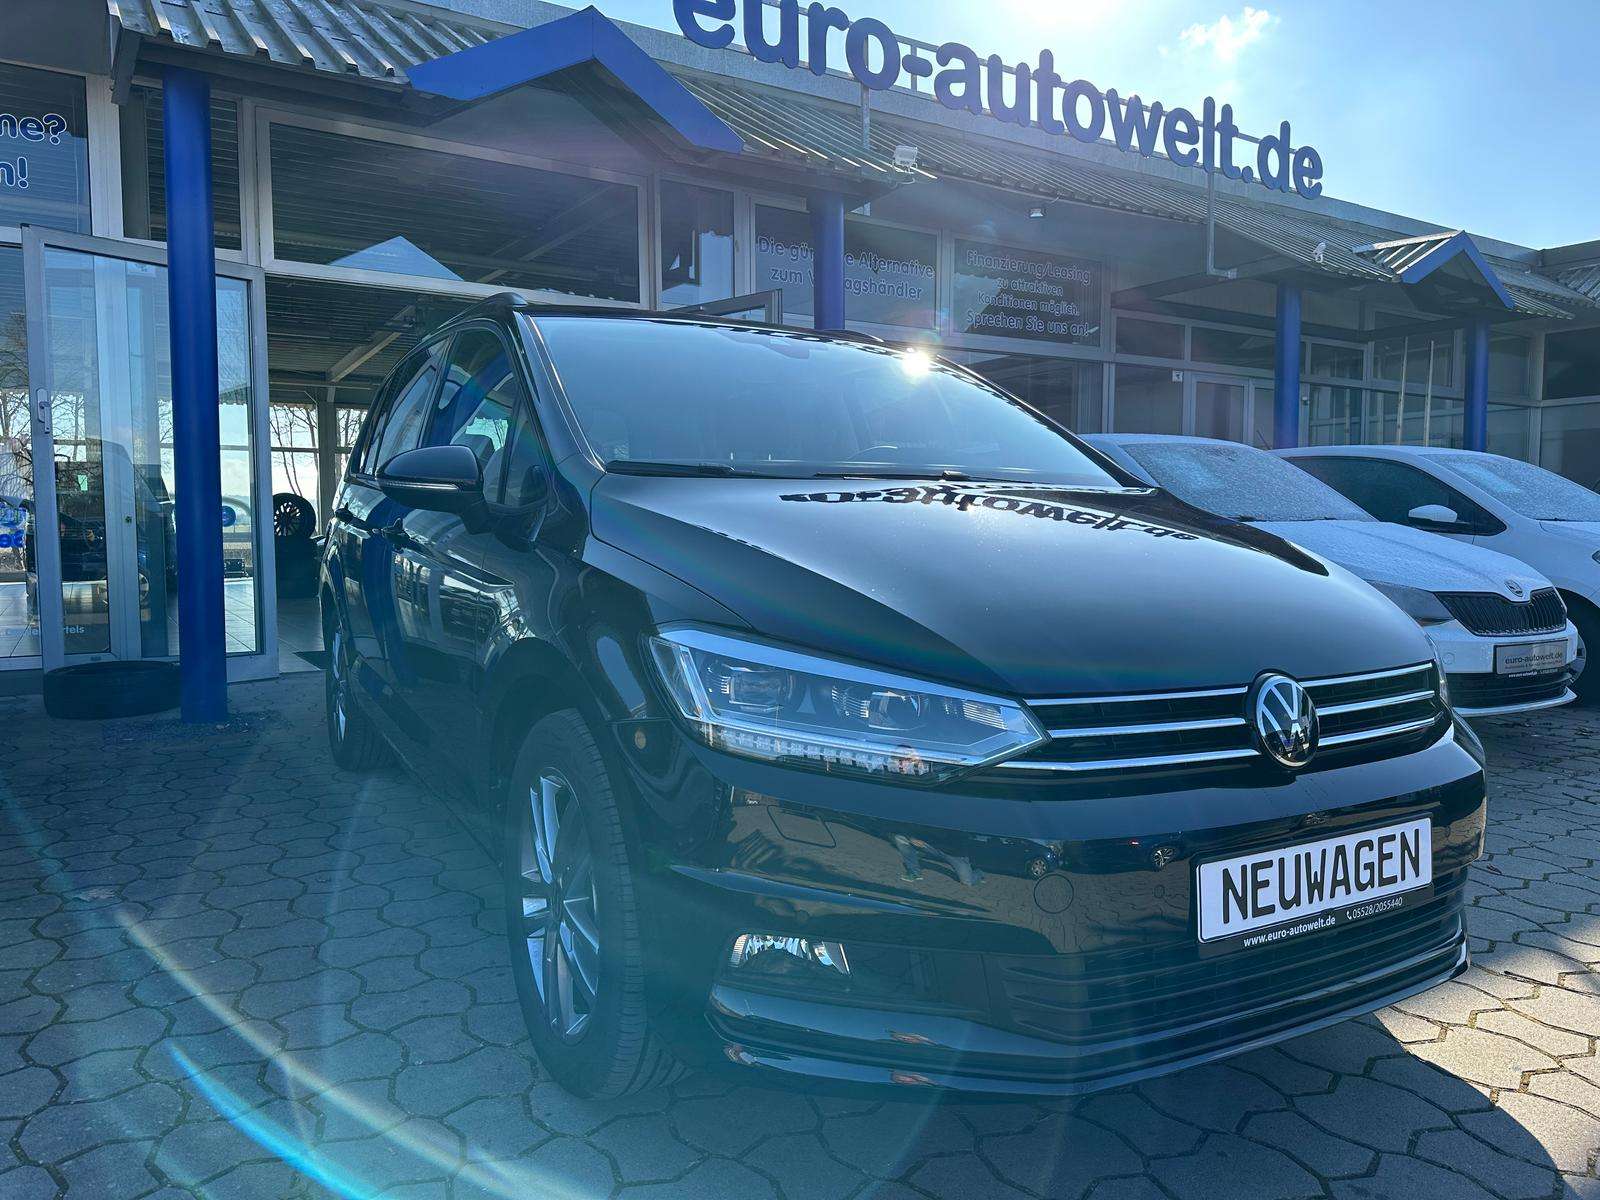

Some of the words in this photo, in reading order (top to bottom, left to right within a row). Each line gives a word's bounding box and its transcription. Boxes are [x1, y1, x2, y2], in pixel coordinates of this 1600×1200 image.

[673, 0, 1323, 199] euro-autowelt.de
[757, 235, 785, 257] Die
[859, 250, 936, 280] Alternative
[966, 250, 1092, 286] Finanzierung/Leasing
[769, 266, 804, 284] zum
[1010, 279, 1064, 297] attraktiven
[977, 290, 1037, 311] Konditionen
[966, 310, 1023, 330] Sprechen
[1025, 315, 1045, 333] Sie
[1047, 320, 1067, 334] uns
[1070, 321, 1090, 337] an!
[1222, 828, 1420, 924] NEUWAGEN
[1243, 914, 1336, 948] www.euro-autowelt.de
